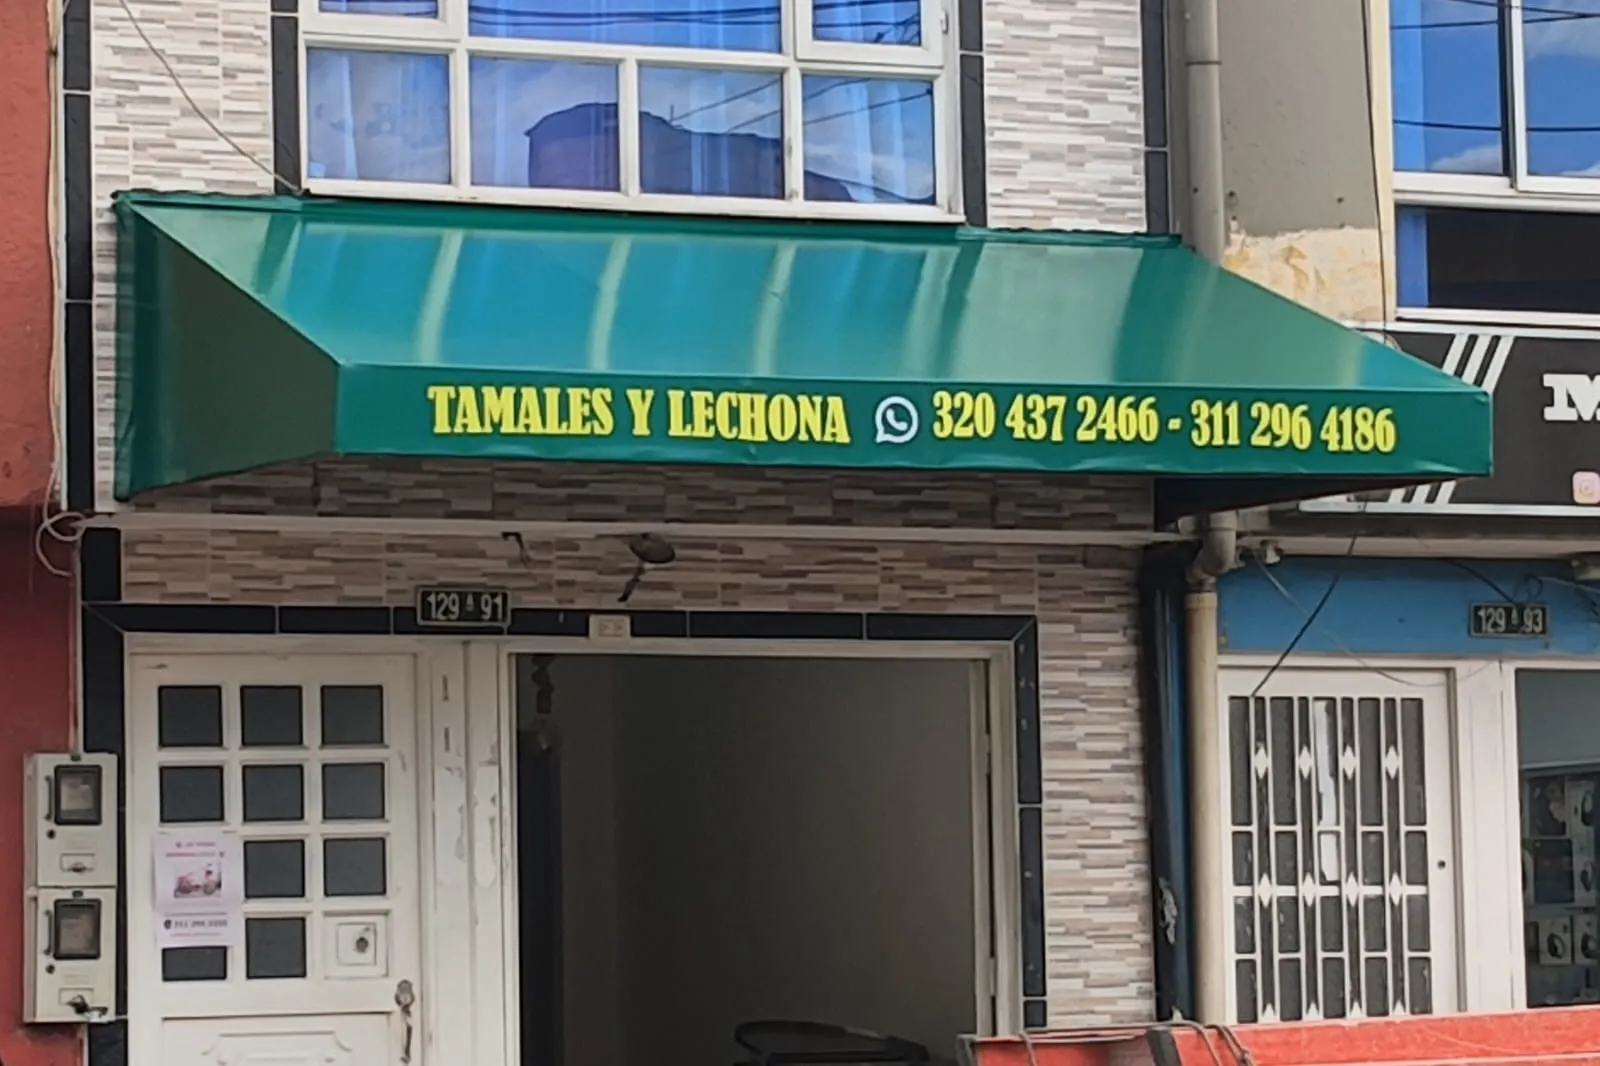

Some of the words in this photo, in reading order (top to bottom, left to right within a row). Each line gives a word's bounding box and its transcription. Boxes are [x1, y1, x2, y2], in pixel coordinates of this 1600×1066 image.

[427, 385, 614, 436] TAMALES
[626, 388, 655, 436] Y
[668, 389, 851, 444] LECHONA
[932, 390, 996, 439] 320
[1004, 393, 1067, 442] 437
[1076, 395, 1159, 443] 2466
[1168, 418, 1182, 432] -
[1191, 399, 1240, 447] 311
[1250, 401, 1312, 450] 296
[1320, 405, 1396, 453] 4186
[427, 591, 460, 621] 129
[480, 593, 503, 621] 91
[1477, 606, 1506, 633] 129
[1523, 607, 1543, 633] 93
